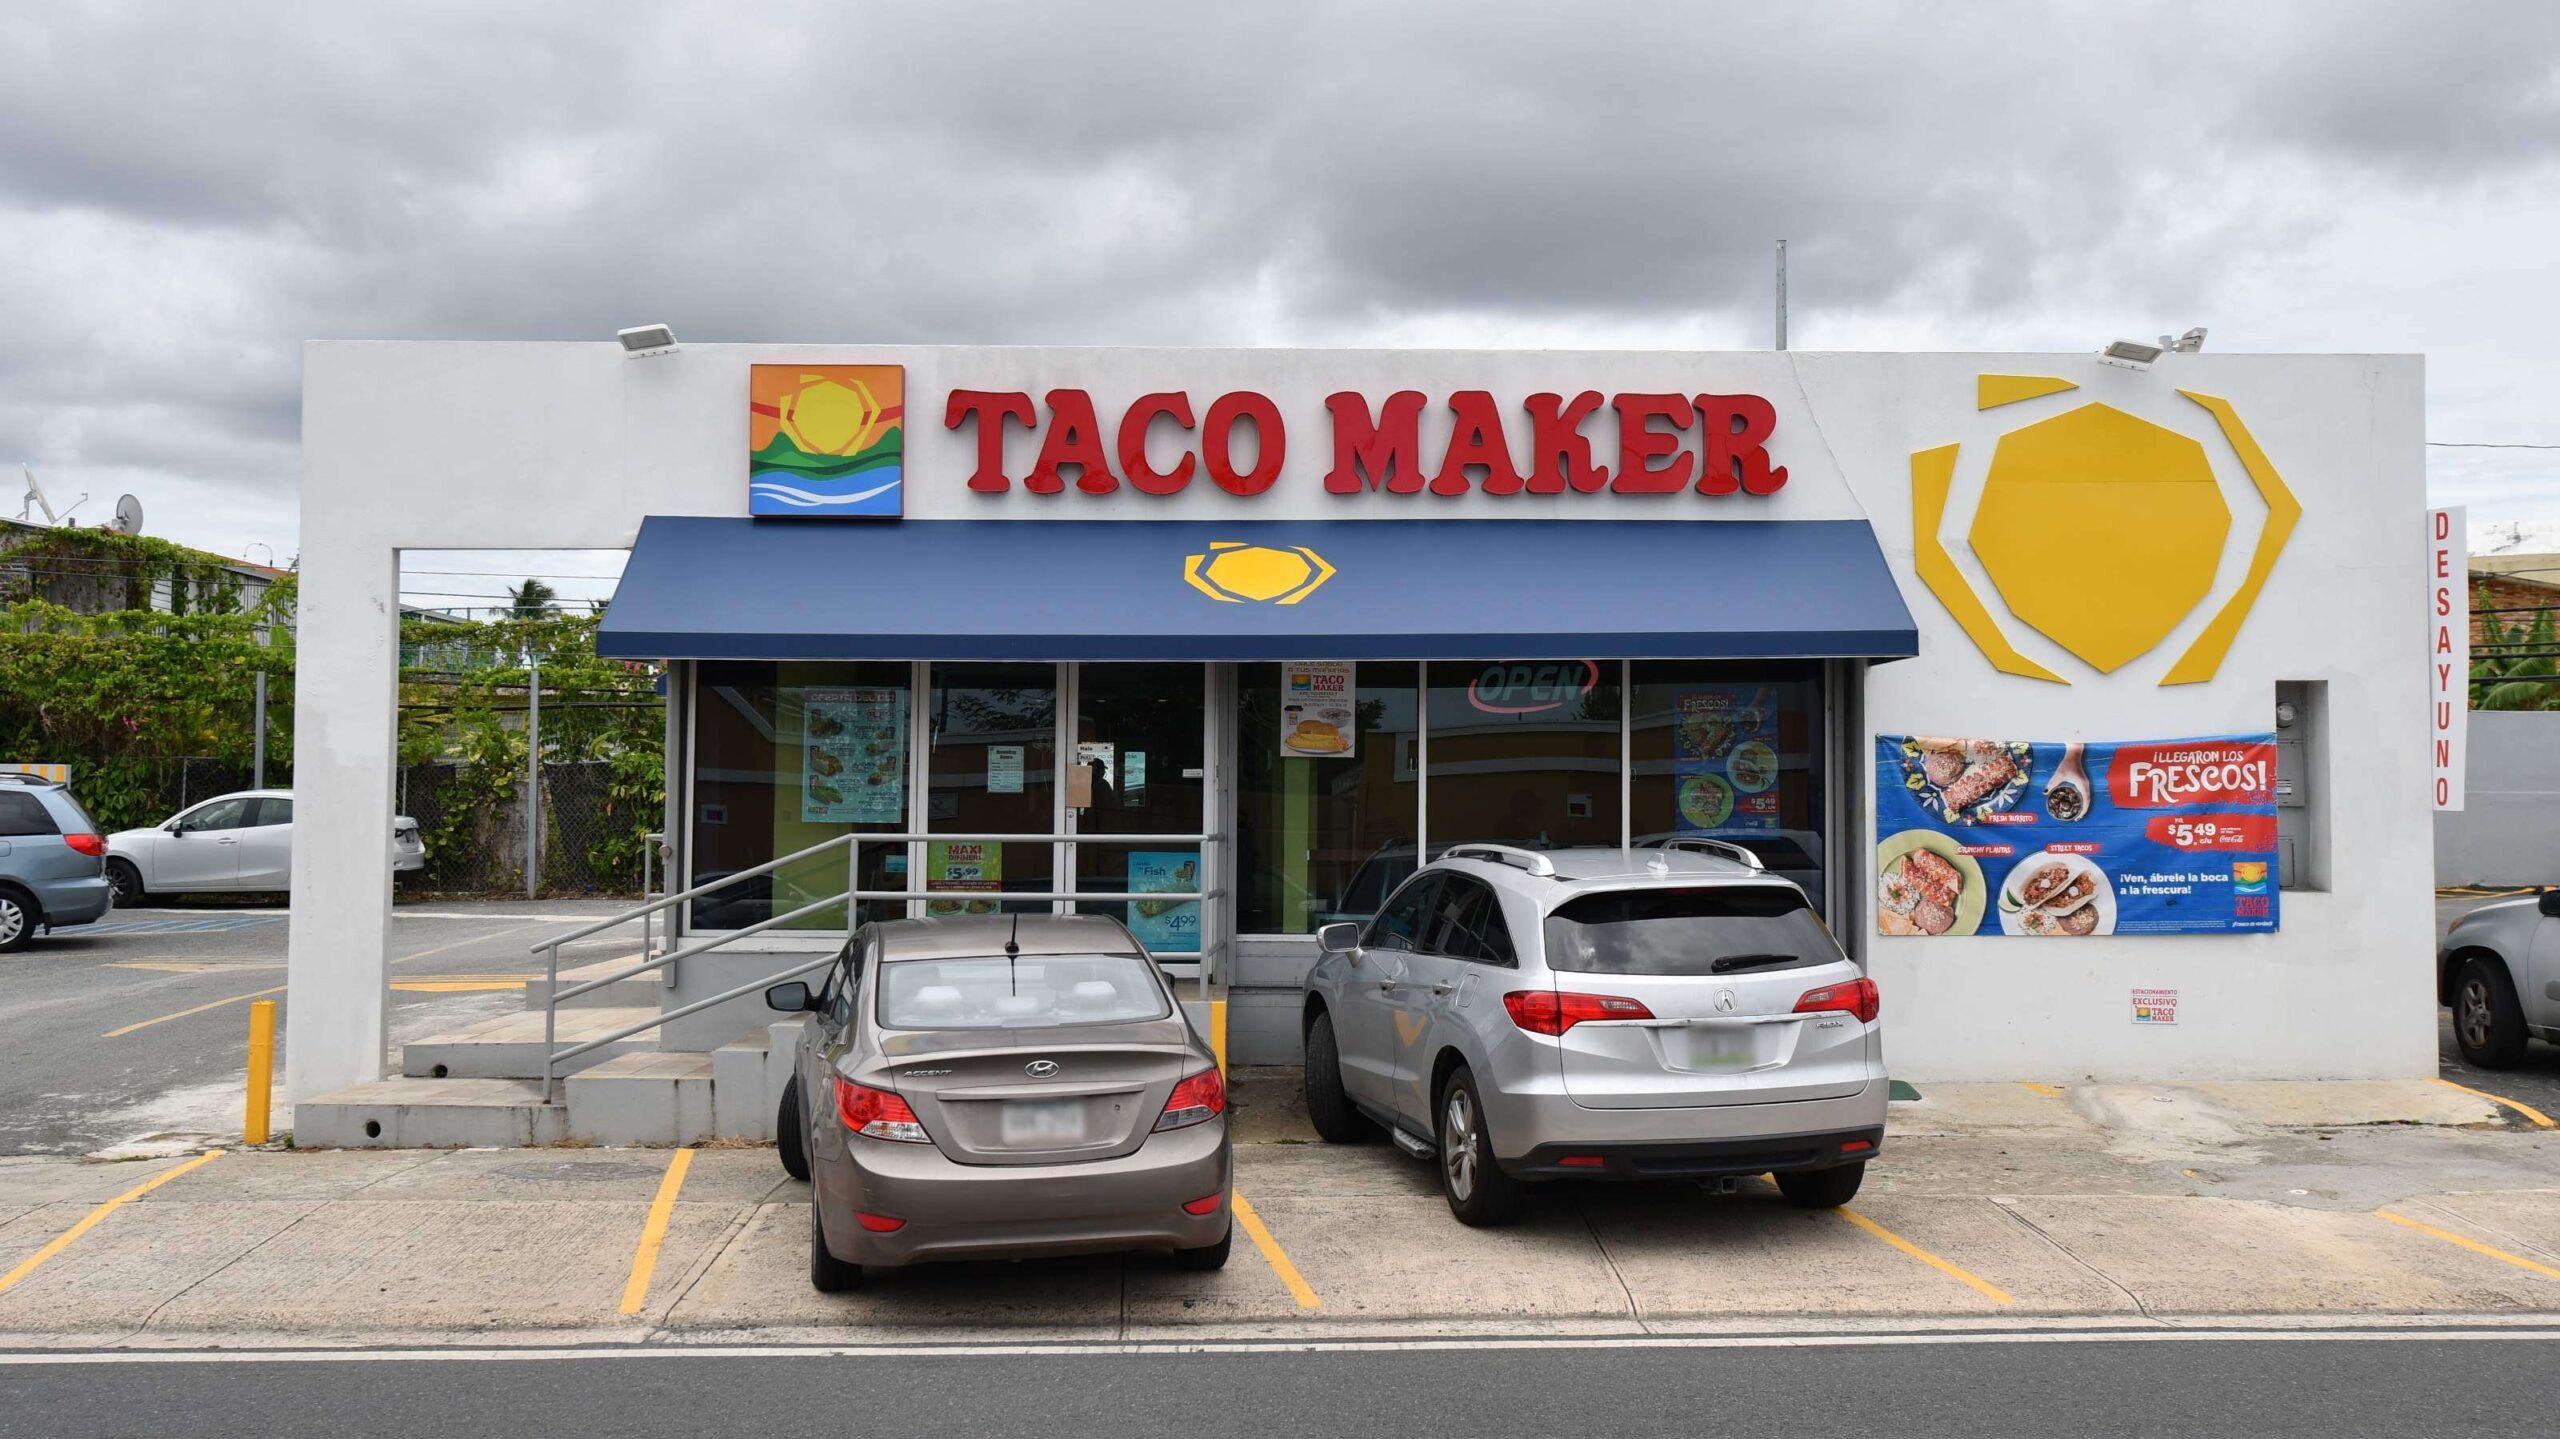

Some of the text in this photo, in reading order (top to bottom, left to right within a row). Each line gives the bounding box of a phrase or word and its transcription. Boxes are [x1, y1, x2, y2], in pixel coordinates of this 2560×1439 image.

[944, 388, 1789, 498] TACO MAKER
[2435, 511, 2452, 807] DESAYUNO
[1313, 675, 1344, 685] TACO
[1476, 665, 1584, 701] OPEN
[2153, 750, 2244, 765] ¡LLEGARON LOS
[2129, 760, 2267, 803] FRESCOS!
[1989, 814, 2033, 822] FRESH BURRITO
[948, 845, 982, 855] MAXI
[1985, 846, 2011, 854] FLAUTAS
[947, 867, 979, 880] $5.99
[1144, 866, 1166, 876] Fish
[2120, 871, 2229, 884] ¡Ven, ábrele la boca
[2120, 885, 2192, 895] a la frescura!
[2235, 895, 2269, 907] TACO
[2132, 998, 2177, 1006] EXCLUSIVO
[2152, 1008, 2174, 1016] TACO
[903, 1069, 953, 1078] ACCENT
